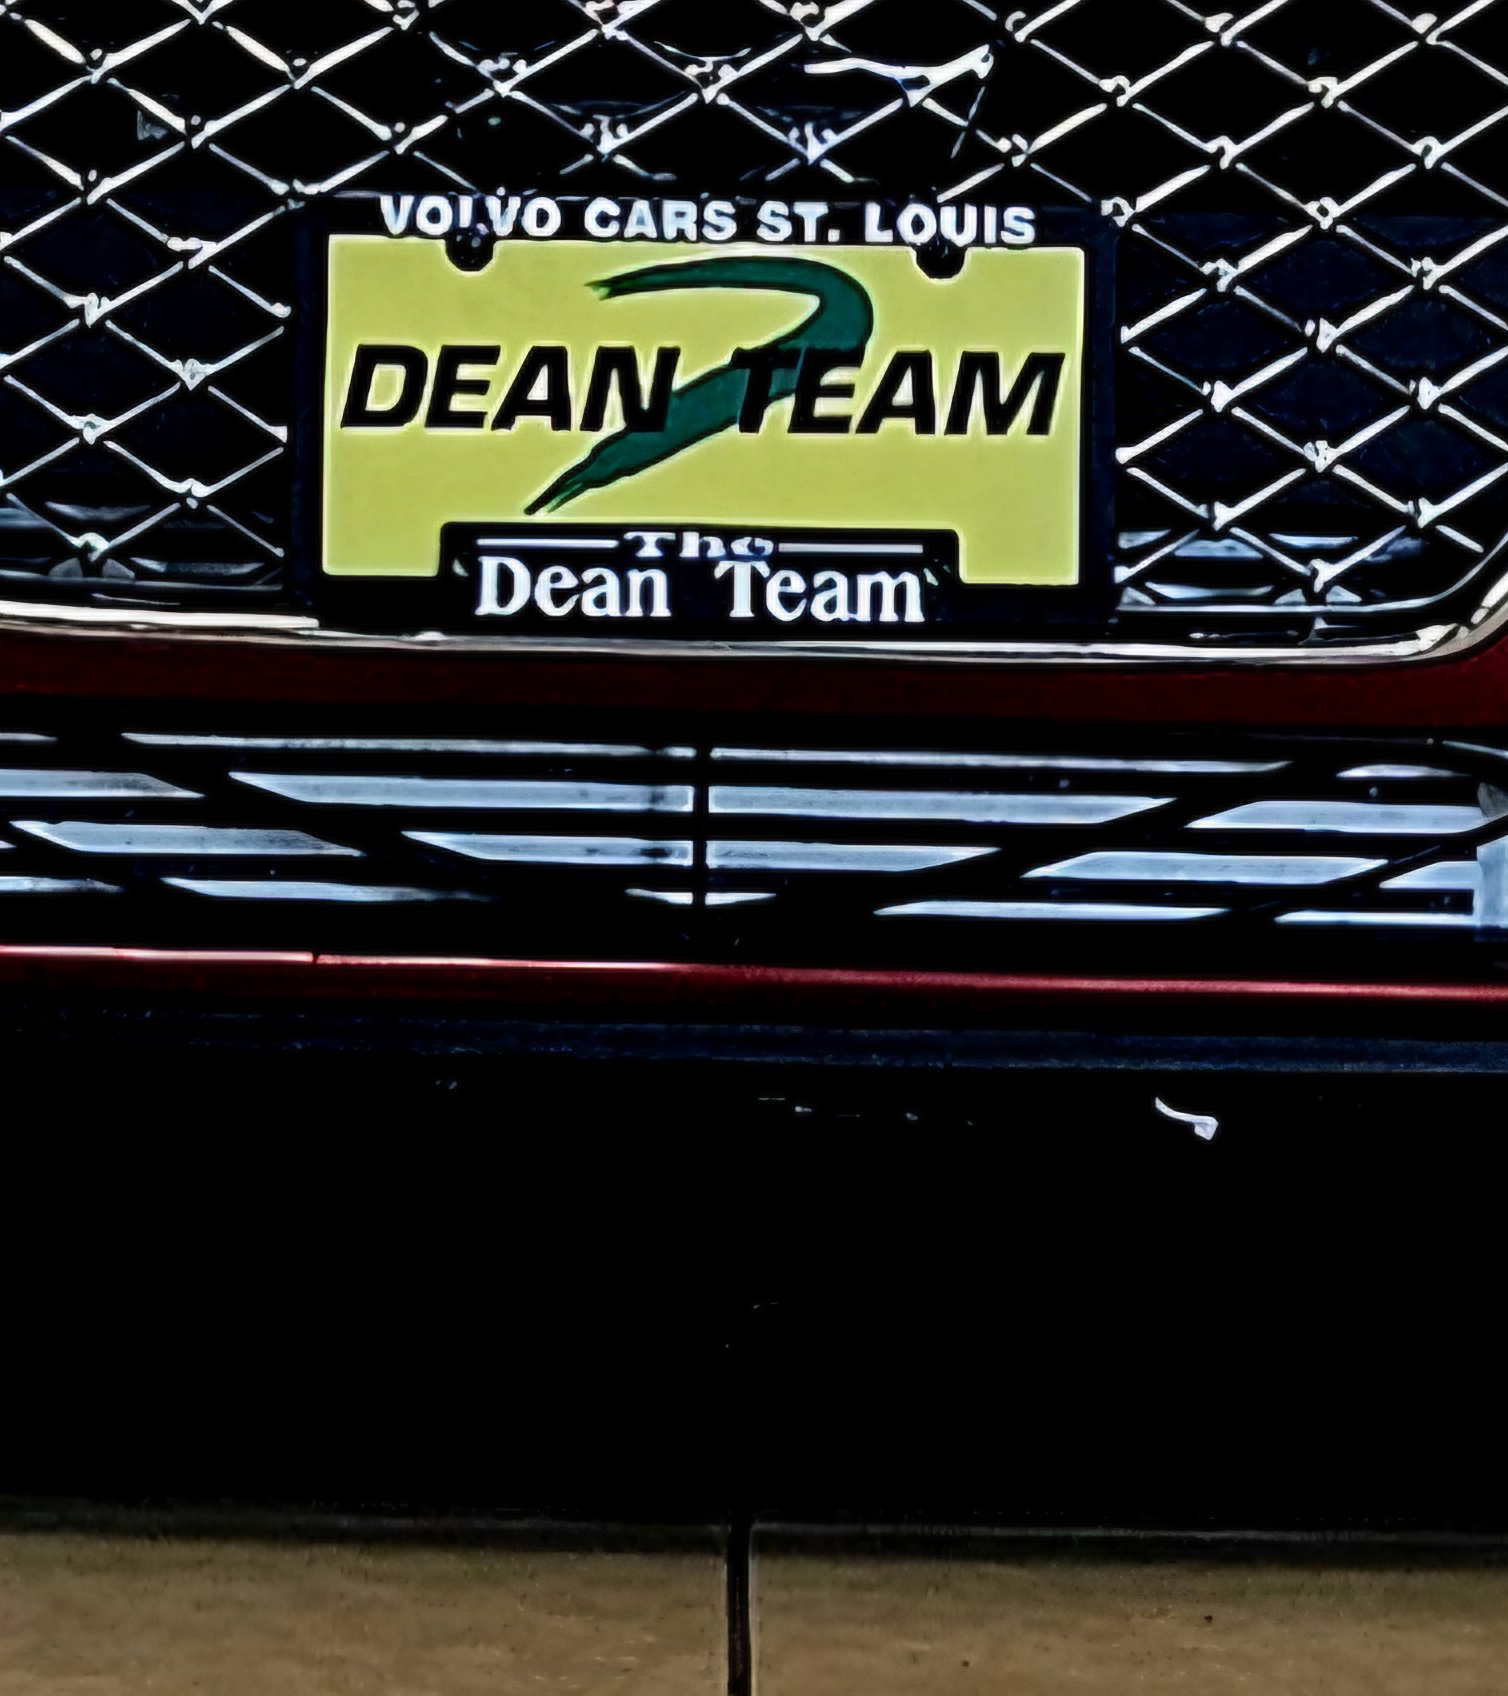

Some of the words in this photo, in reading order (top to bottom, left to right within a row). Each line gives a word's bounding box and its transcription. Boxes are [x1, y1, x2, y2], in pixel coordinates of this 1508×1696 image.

[584, 197, 738, 241] CARS
[756, 200, 841, 243] ST.
[865, 202, 1036, 247] LOUIS
[340, 343, 682, 432] DEAN
[730, 347, 1067, 436] TEAM
[474, 555, 673, 618] Dean
[713, 560, 926, 623] Team
